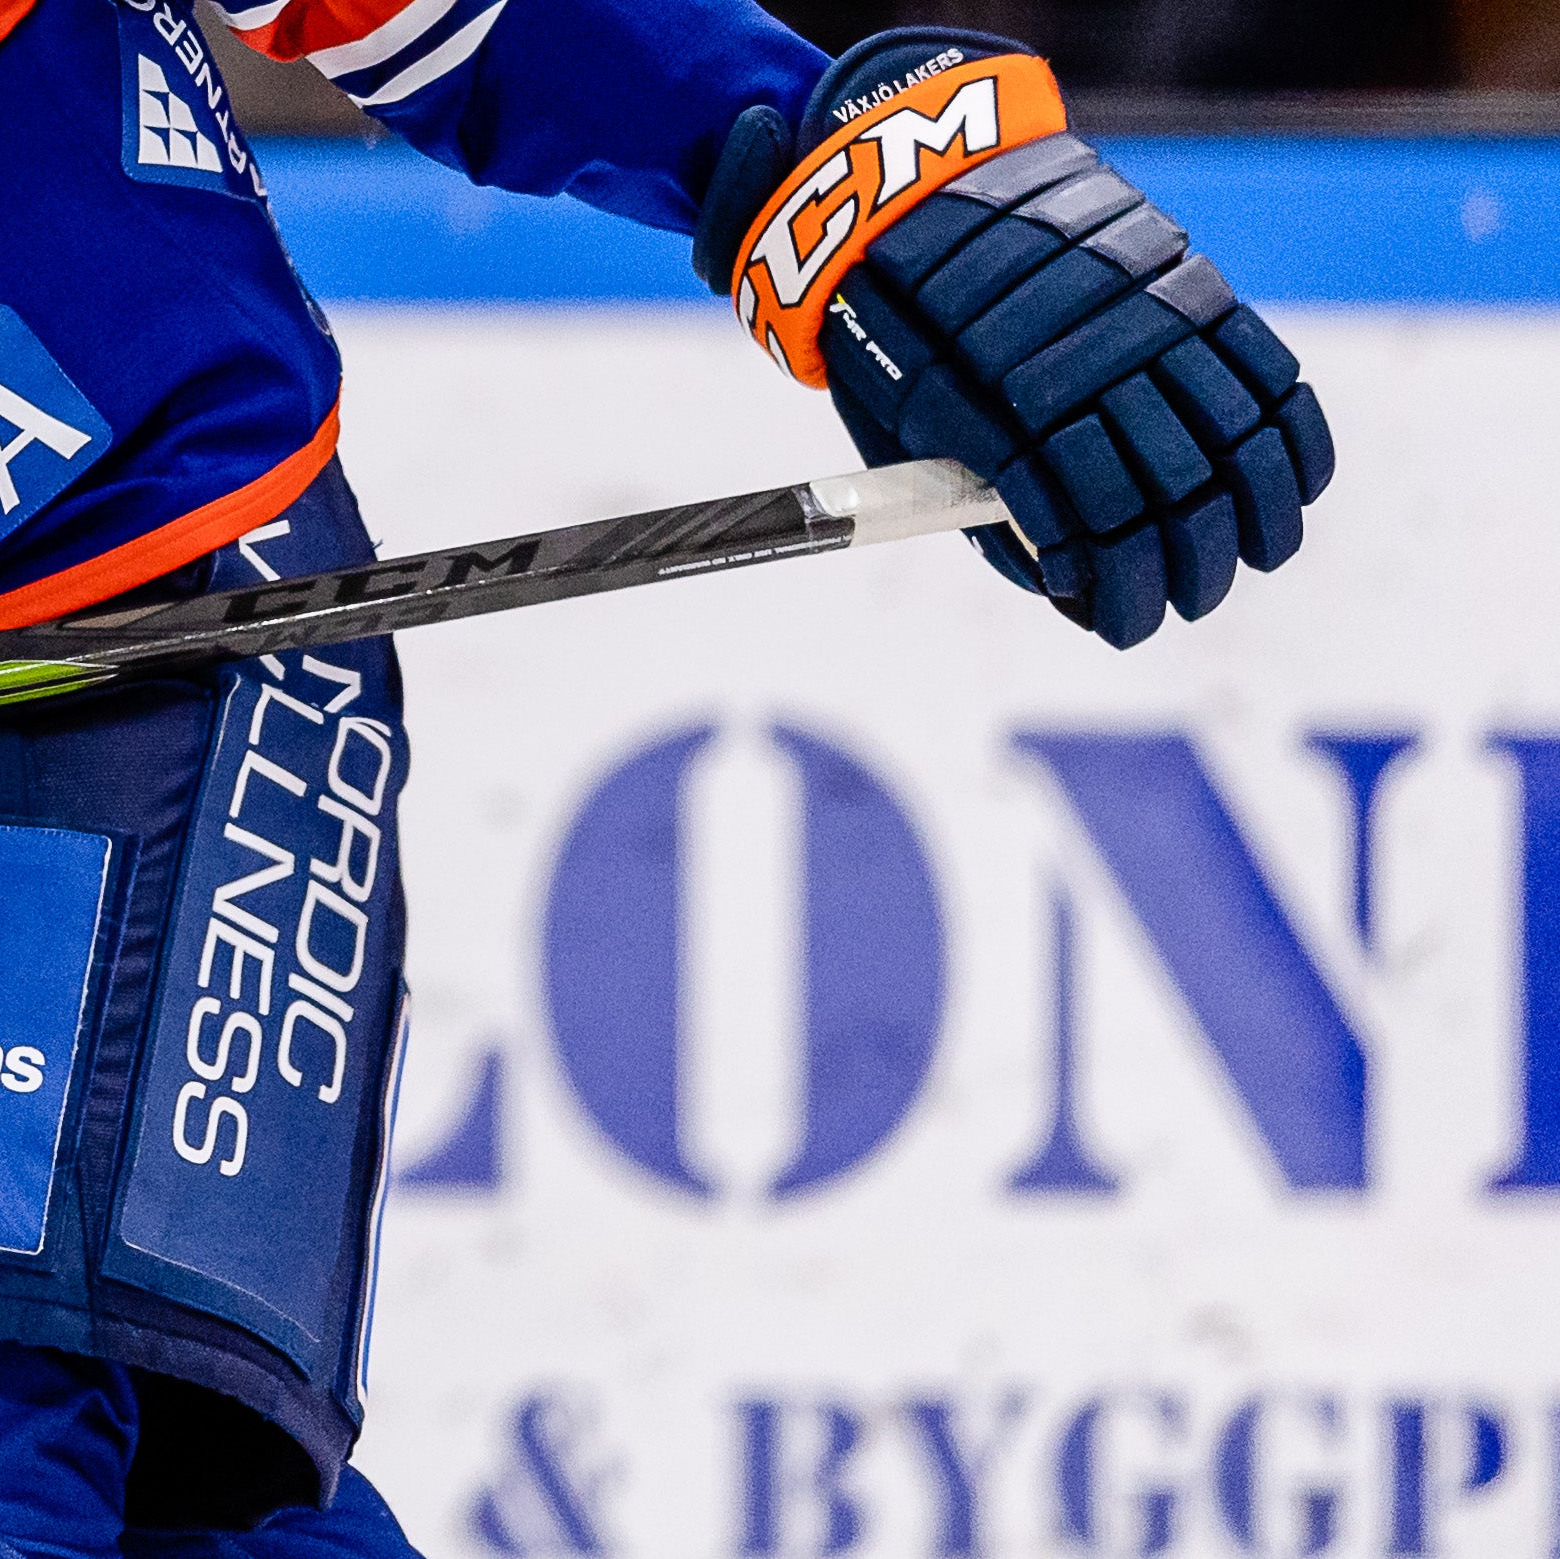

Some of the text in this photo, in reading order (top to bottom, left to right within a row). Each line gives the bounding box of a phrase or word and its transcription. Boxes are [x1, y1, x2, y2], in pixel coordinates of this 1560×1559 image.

[831, 47, 965, 125] VÄXJÖ LAKERS
[221, 538, 543, 625] CCM
[729, 1382, 1560, 1559] BYGGP
